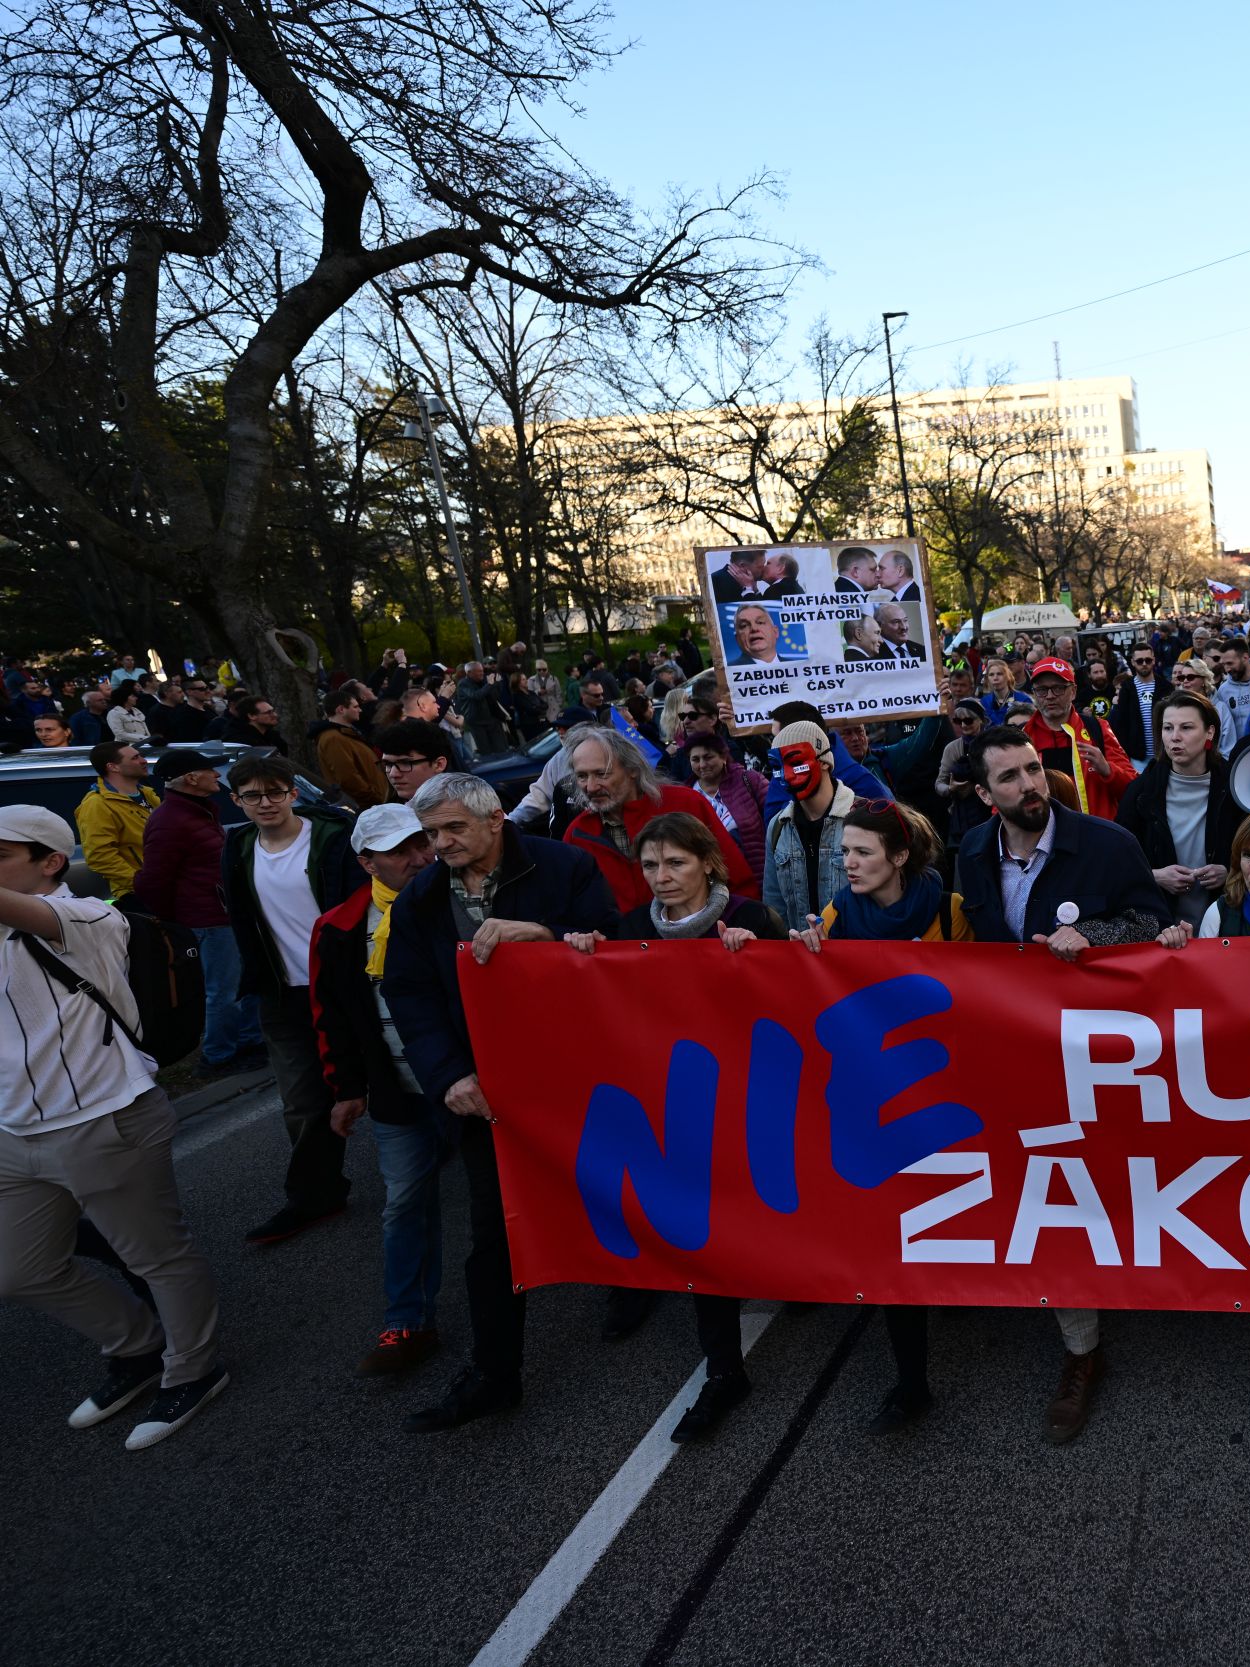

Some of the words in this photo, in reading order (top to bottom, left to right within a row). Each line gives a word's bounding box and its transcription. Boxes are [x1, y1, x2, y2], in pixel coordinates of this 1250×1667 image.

[783, 593, 870, 607] MAFIÁNSKY
[780, 608, 861, 623] DIKTÁTORI
[733, 667, 798, 682] ZABUDLI
[803, 664, 830, 677] STE
[835, 660, 896, 675] RUSKOM
[900, 659, 920, 670] NA
[738, 682, 790, 698] VEČNÉ
[807, 678, 846, 692] ČASY
[819, 702, 854, 715] ESTA
[858, 698, 878, 711] DO
[882, 692, 940, 708] MOSKVY
[575, 974, 985, 1259] NIE
